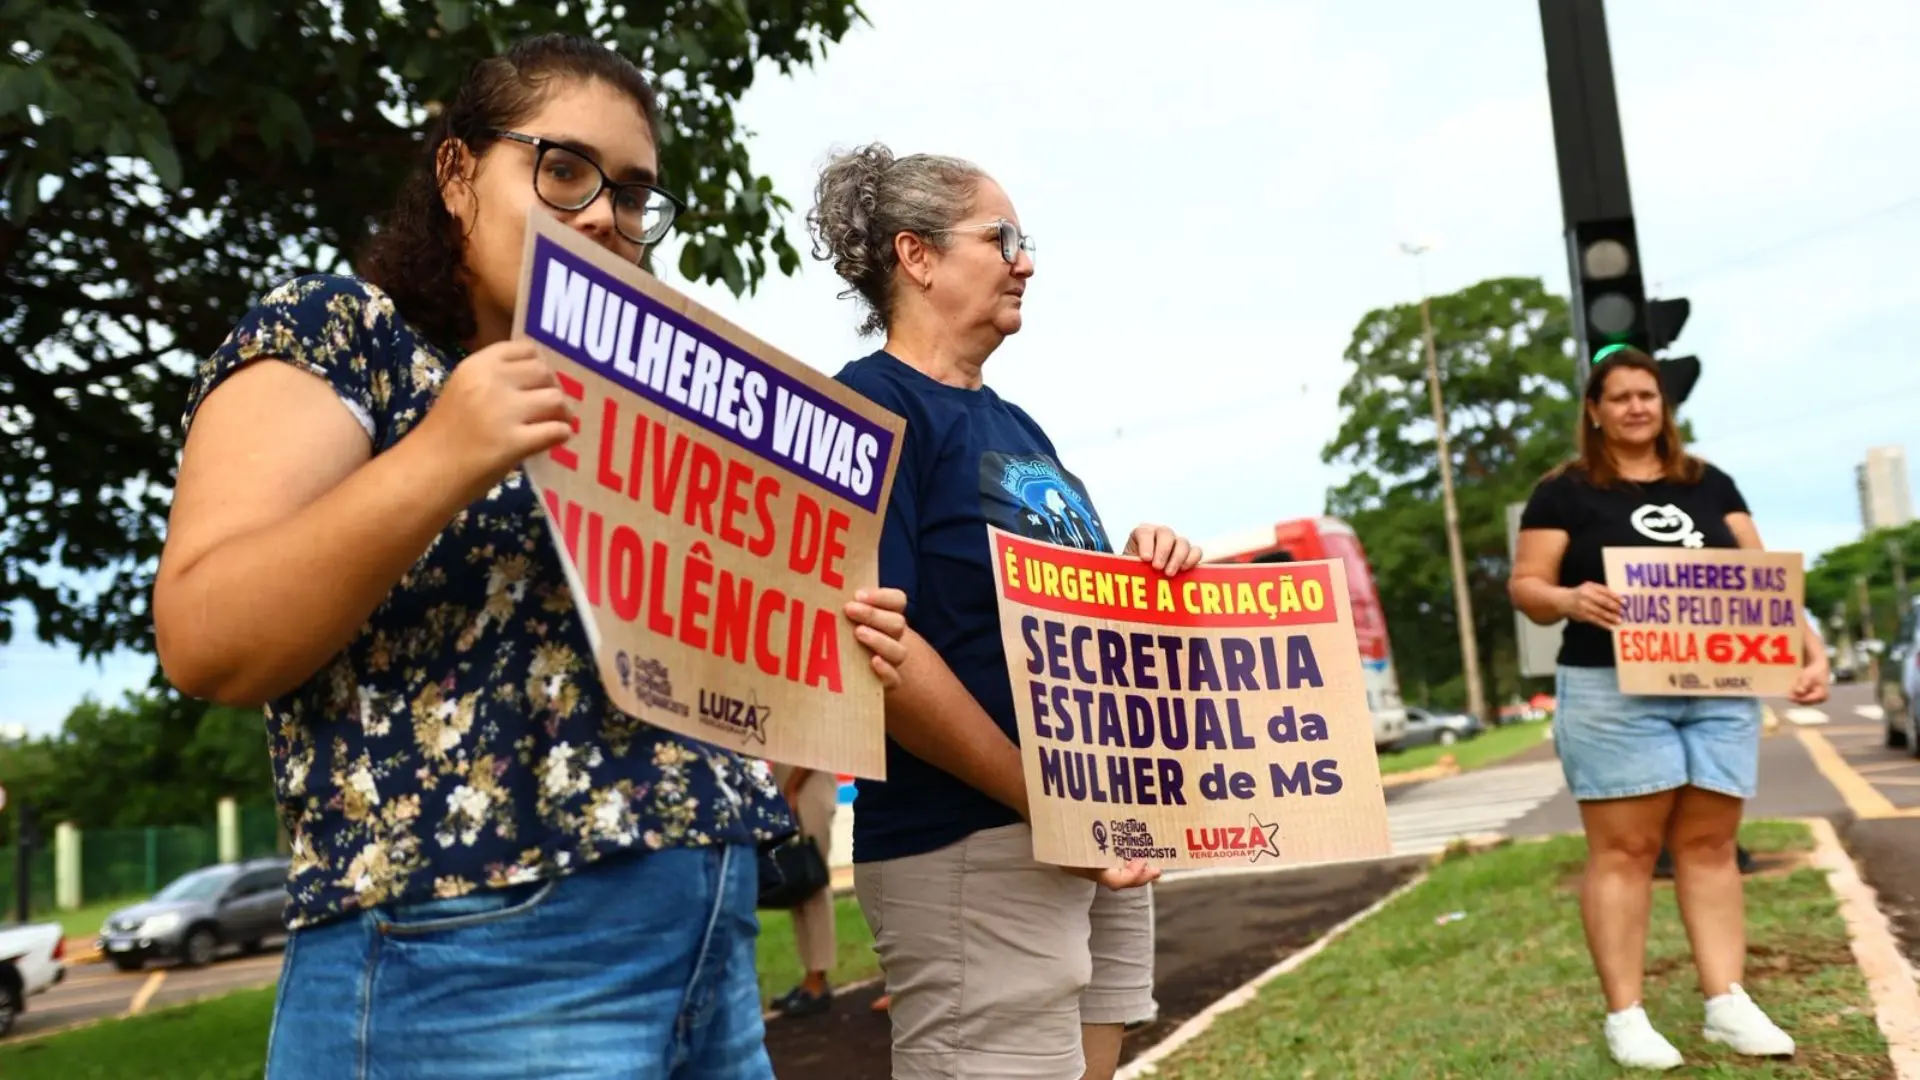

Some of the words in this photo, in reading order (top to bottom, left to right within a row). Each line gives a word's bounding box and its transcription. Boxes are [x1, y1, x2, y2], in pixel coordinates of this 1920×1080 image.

[541, 257, 768, 441] MULHERES
[772, 386, 878, 497] VIVAS
[597, 396, 781, 558] LIVRES
[788, 493, 851, 590] DE
[1005, 547, 1021, 588] É
[1025, 560, 1148, 611] URGENTE
[1157, 579, 1176, 613] A
[1183, 575, 1324, 621] CRIAÇÃO
[1625, 562, 1746, 591] MULHERES
[1752, 567, 1787, 592] NAS
[1620, 595, 1670, 624] RUAS
[1677, 596, 1722, 626] PELO
[1729, 597, 1763, 626] FIM
[1770, 598, 1796, 627] DA
[1021, 615, 1324, 692] SECRETARIA
[1618, 629, 1699, 663] ESCALA
[1704, 632, 1797, 666] 6X1
[700, 688, 758, 731] LUIZA
[1029, 681, 1256, 750] ESTADUAL
[1267, 707, 1329, 743] da
[1038, 746, 1187, 806] MULHER
[1199, 764, 1256, 800] de
[1270, 760, 1343, 798] MS
[1185, 827, 1268, 851] LUIZA
[1189, 850, 1246, 859] VEREADORA
